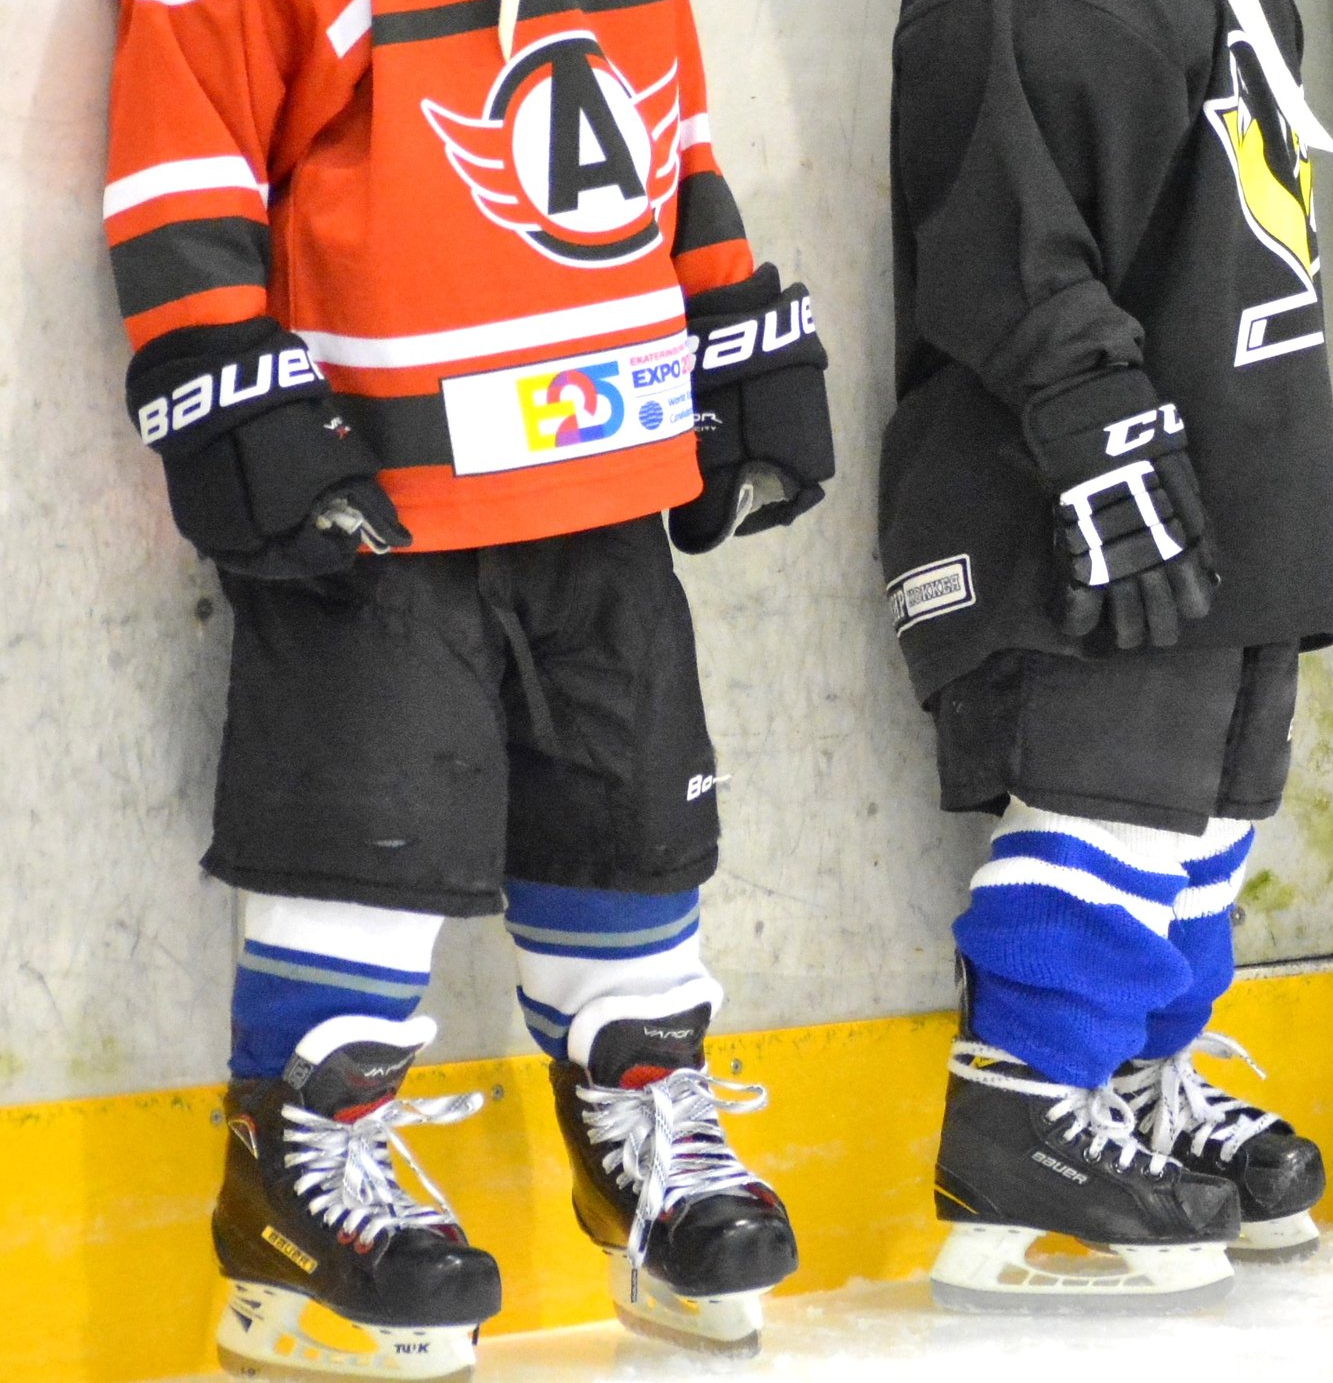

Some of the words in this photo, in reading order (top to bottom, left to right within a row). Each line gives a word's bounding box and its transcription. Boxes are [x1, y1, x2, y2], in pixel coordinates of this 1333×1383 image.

[548, 49, 646, 215] A
[138, 348, 324, 445] BAUE
[632, 360, 680, 389] EXPO
[1032, 1151, 1087, 1184] BAUER
